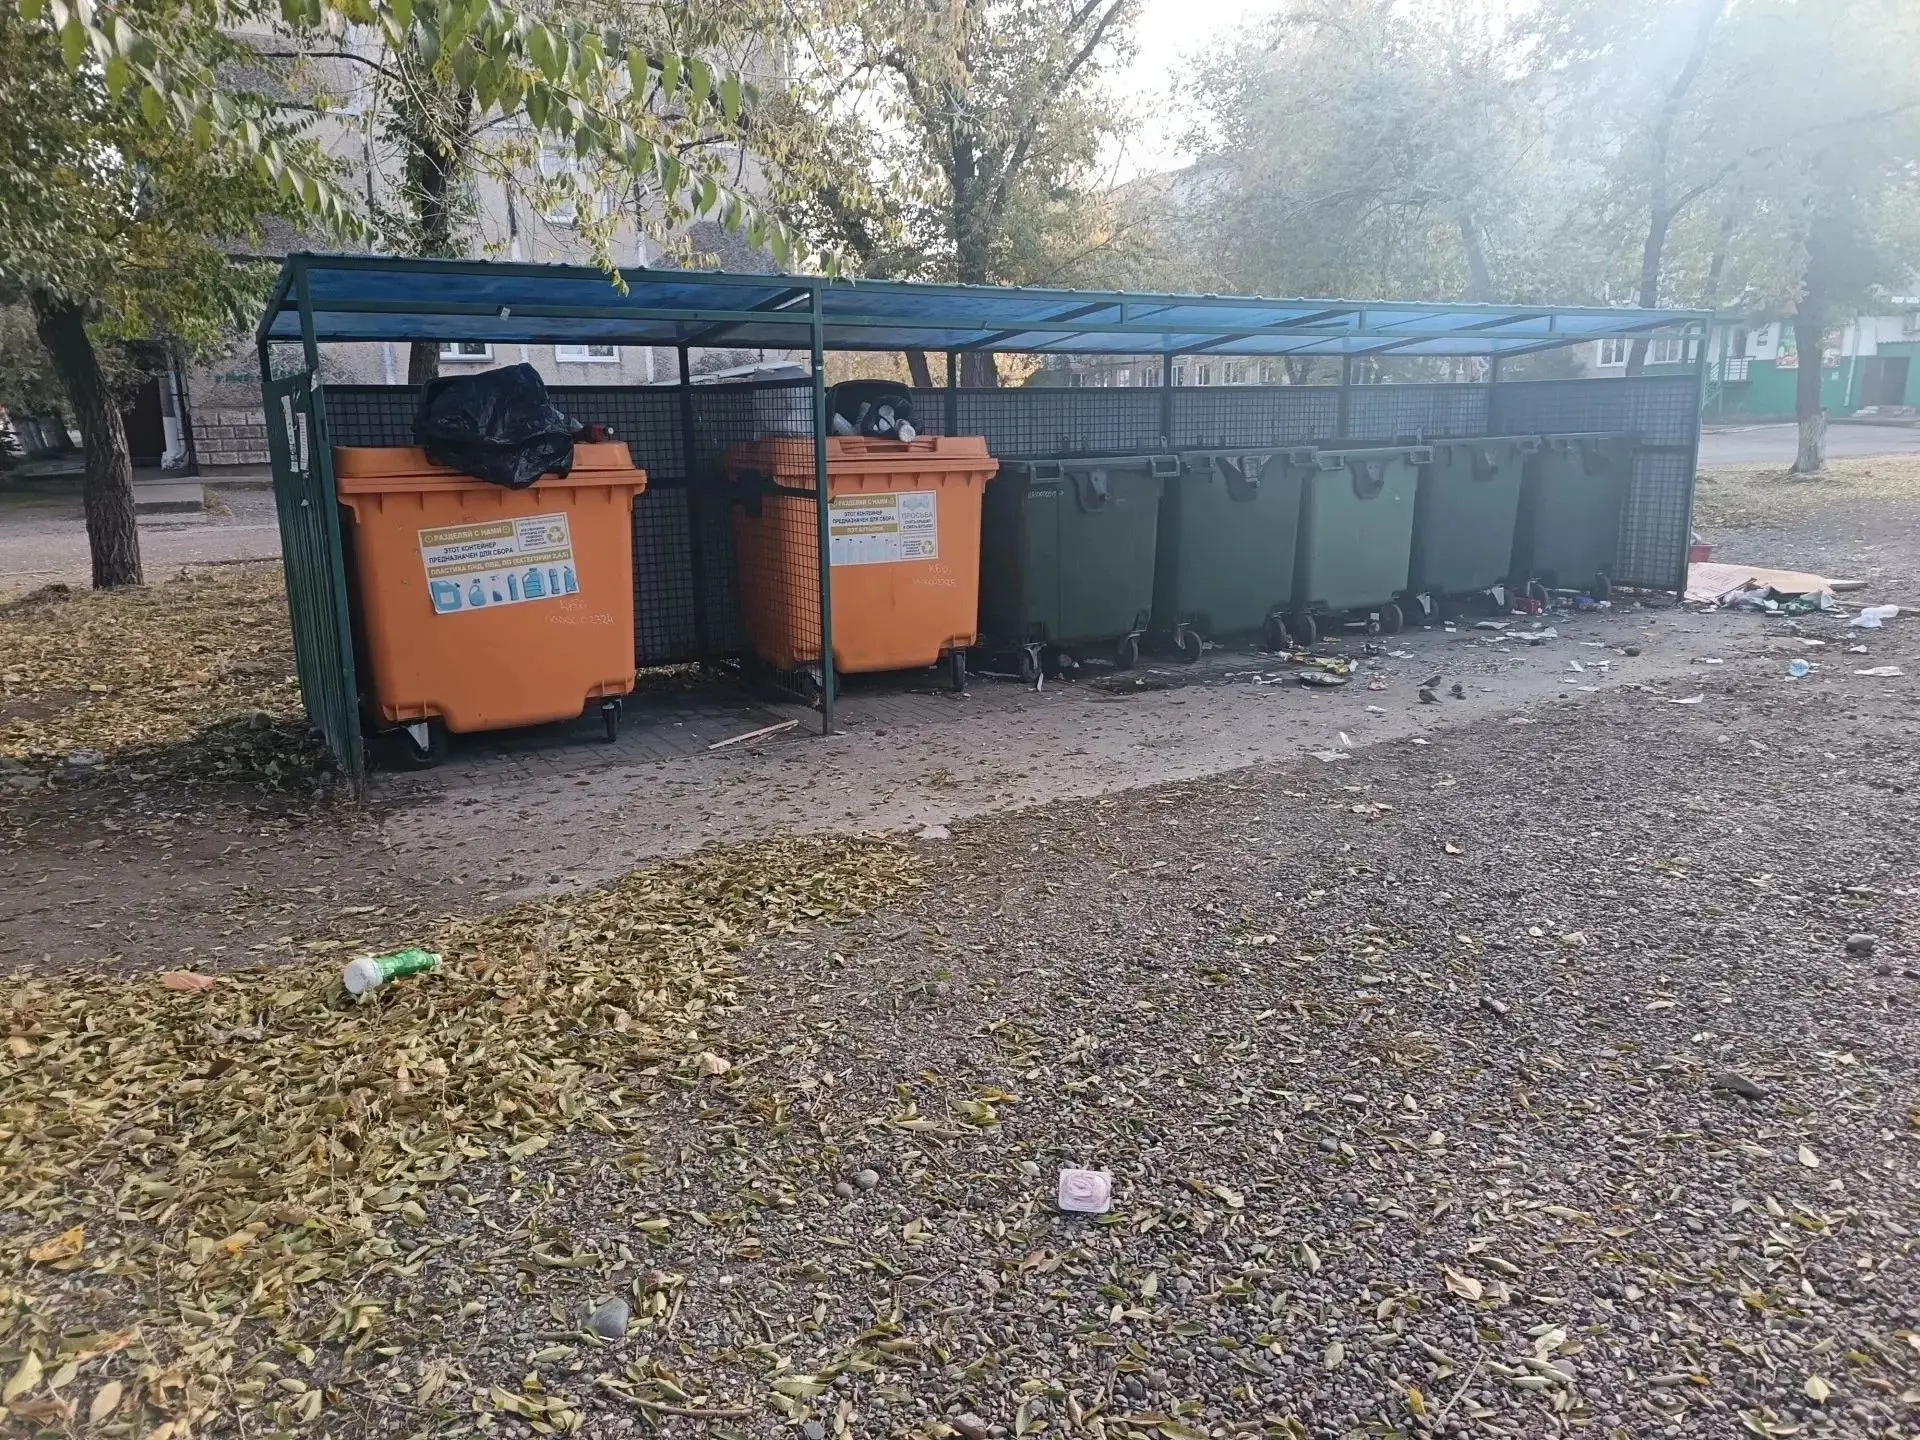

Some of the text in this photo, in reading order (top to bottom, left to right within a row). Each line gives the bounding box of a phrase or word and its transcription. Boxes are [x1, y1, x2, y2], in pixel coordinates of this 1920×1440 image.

[433, 530, 473, 542] РАЗДЕЛЯЙ
[480, 526, 502, 536] НАМИ
[443, 541, 497, 554] ЭТОТ КОНТЕЙНЕР
[429, 547, 514, 564] ПРЕДНАЗНАЧЕН ДЛЯ СБОРА
[430, 565, 466, 576] ПЛАСТИКА
